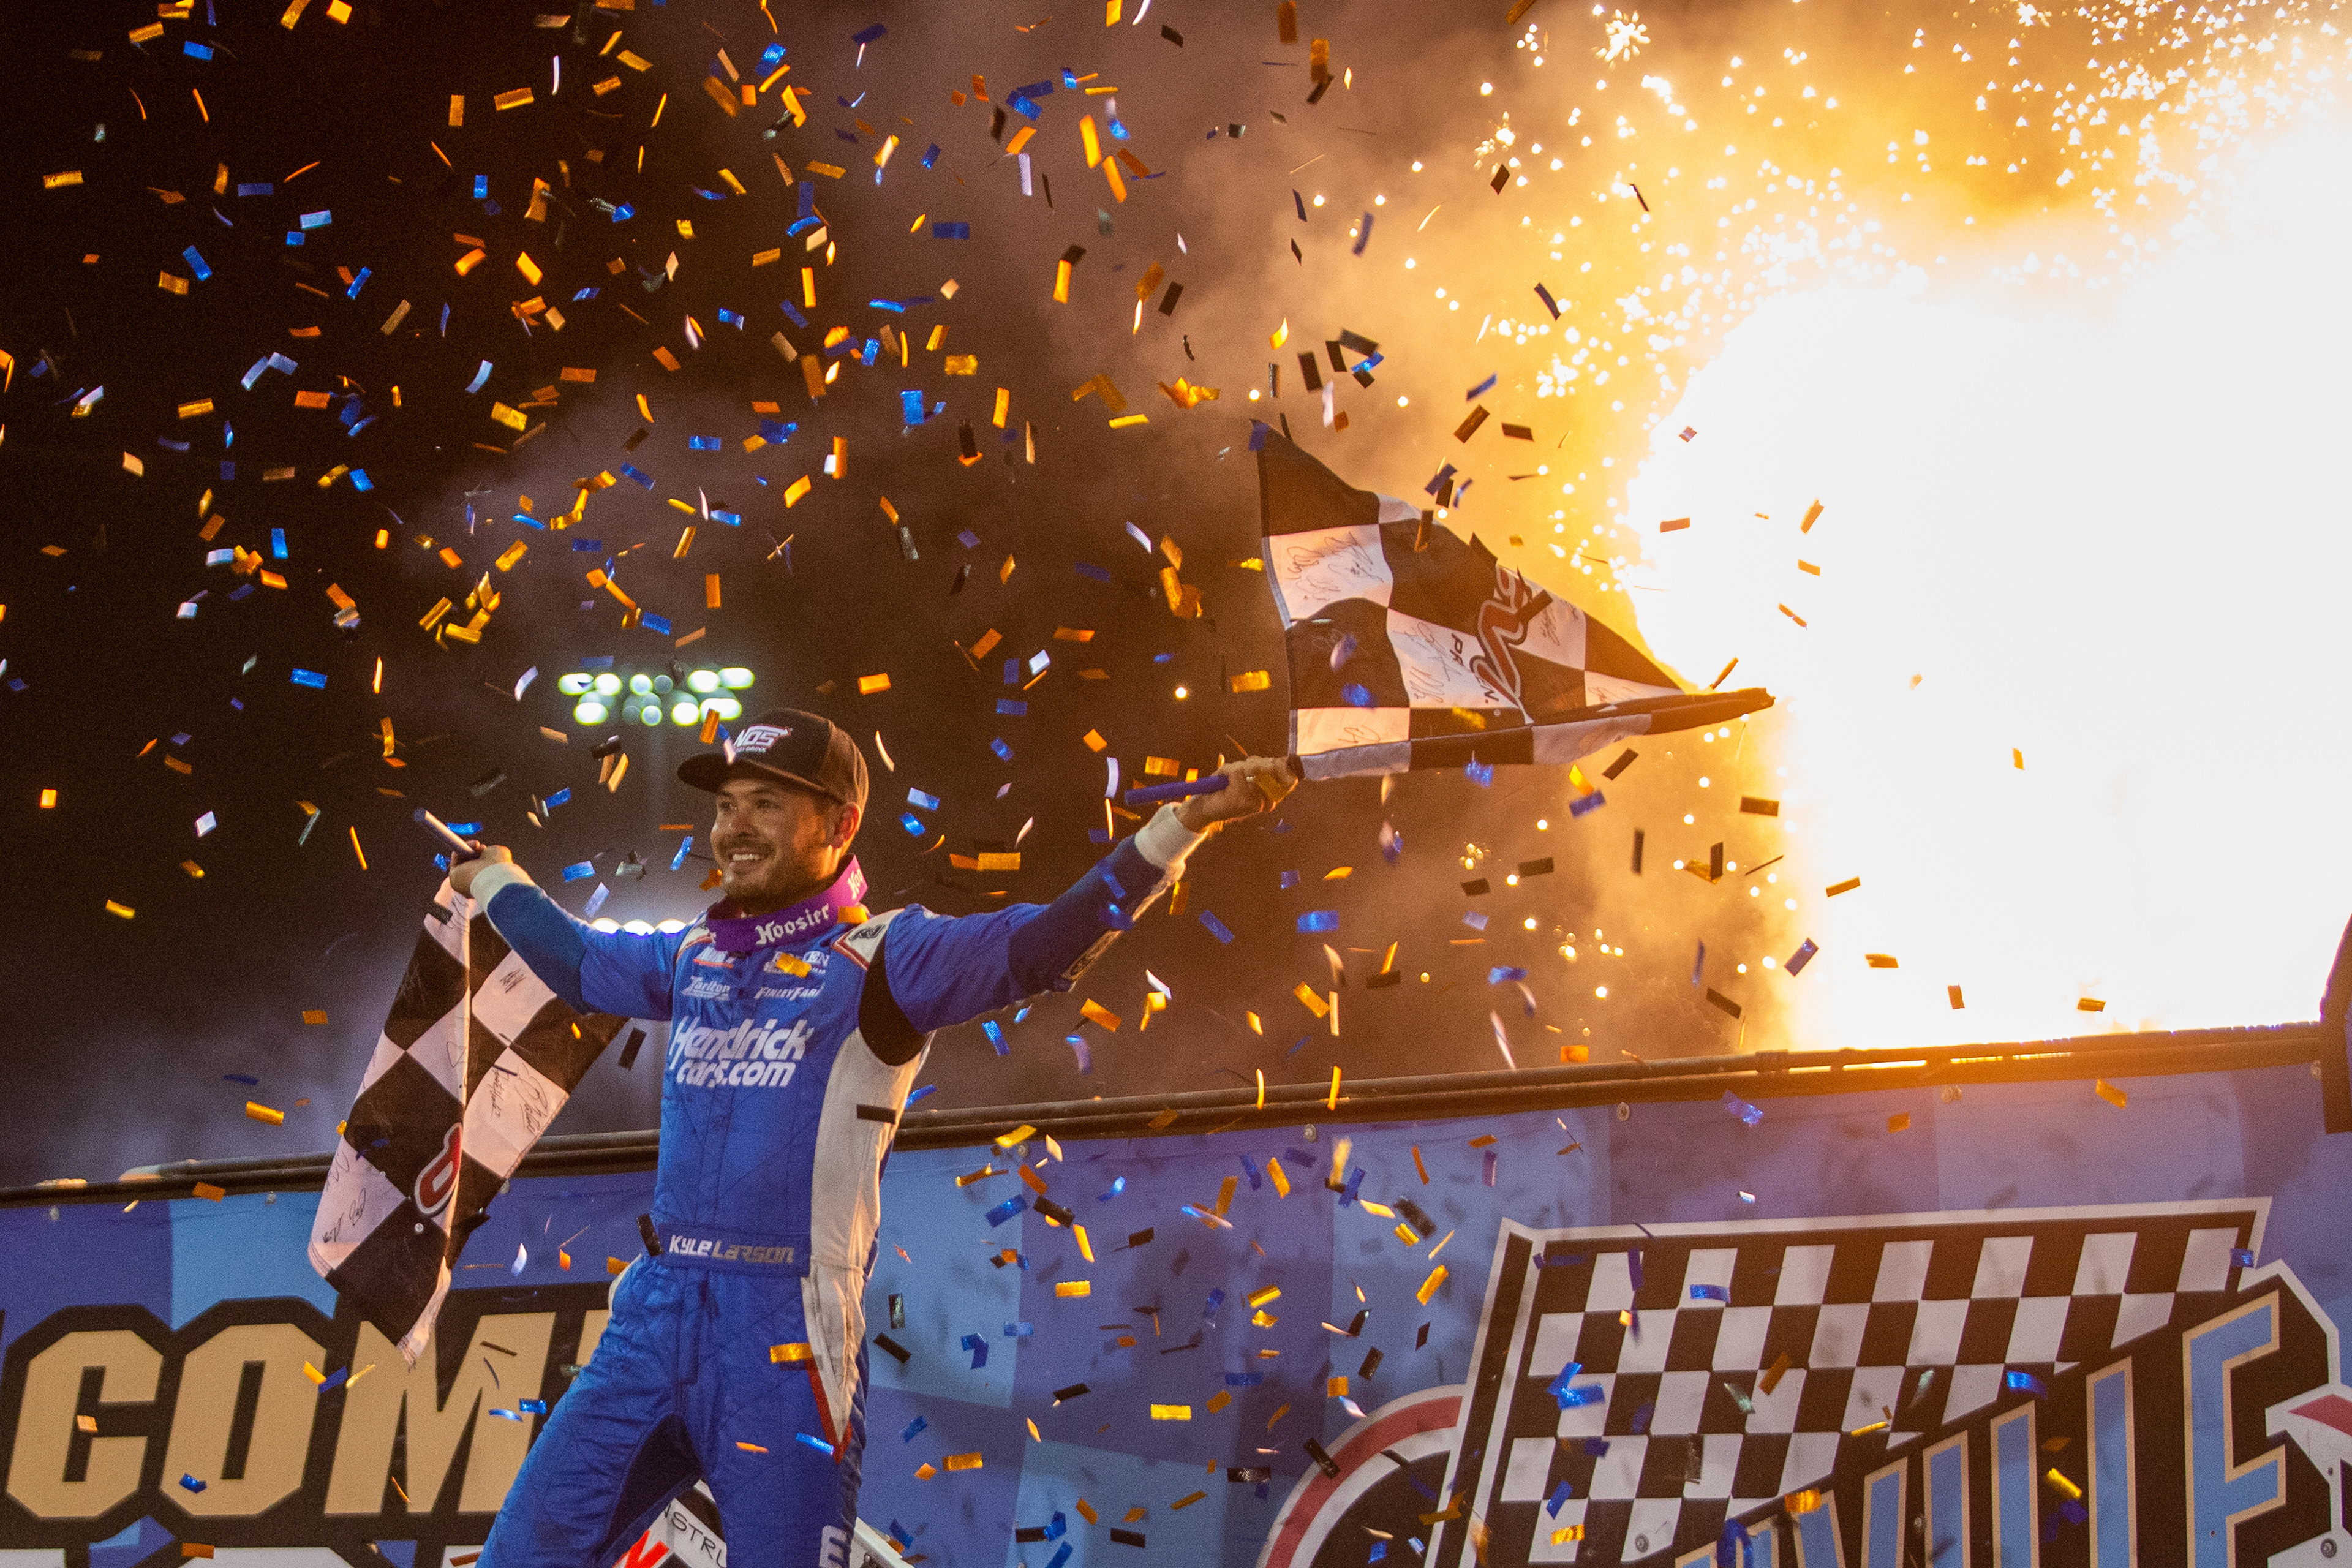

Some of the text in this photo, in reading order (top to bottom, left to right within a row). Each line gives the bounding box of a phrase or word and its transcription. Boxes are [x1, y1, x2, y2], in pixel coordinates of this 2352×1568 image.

[1450, 633, 1499, 703] PREN.
[734, 725, 790, 747] NOS
[754, 903, 830, 945] Hoosier
[668, 1015, 815, 1071] Hendrick
[676, 1060, 797, 1088] cars.com
[5, 1308, 610, 1518] COM
